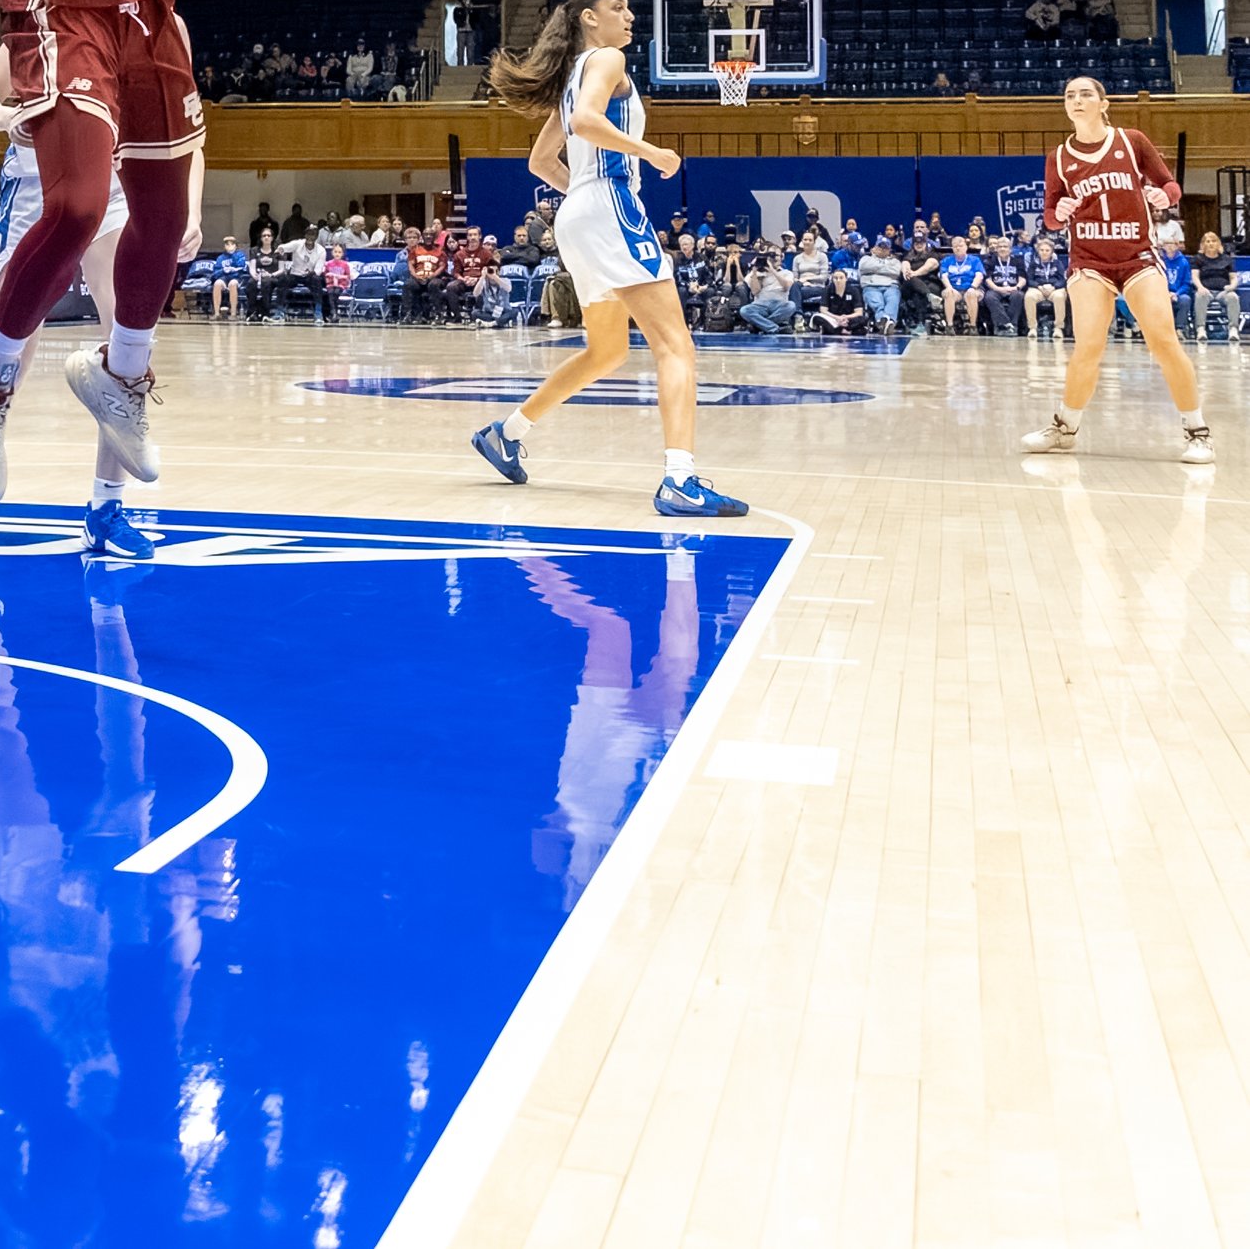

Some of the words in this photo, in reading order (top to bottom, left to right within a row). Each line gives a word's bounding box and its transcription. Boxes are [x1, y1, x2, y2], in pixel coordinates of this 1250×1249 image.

[1073, 172, 1133, 199] BOSTON
[1005, 199, 1045, 216] SISTER
[1099, 193, 1111, 221] 1
[1076, 222, 1140, 240] COLLEGE
